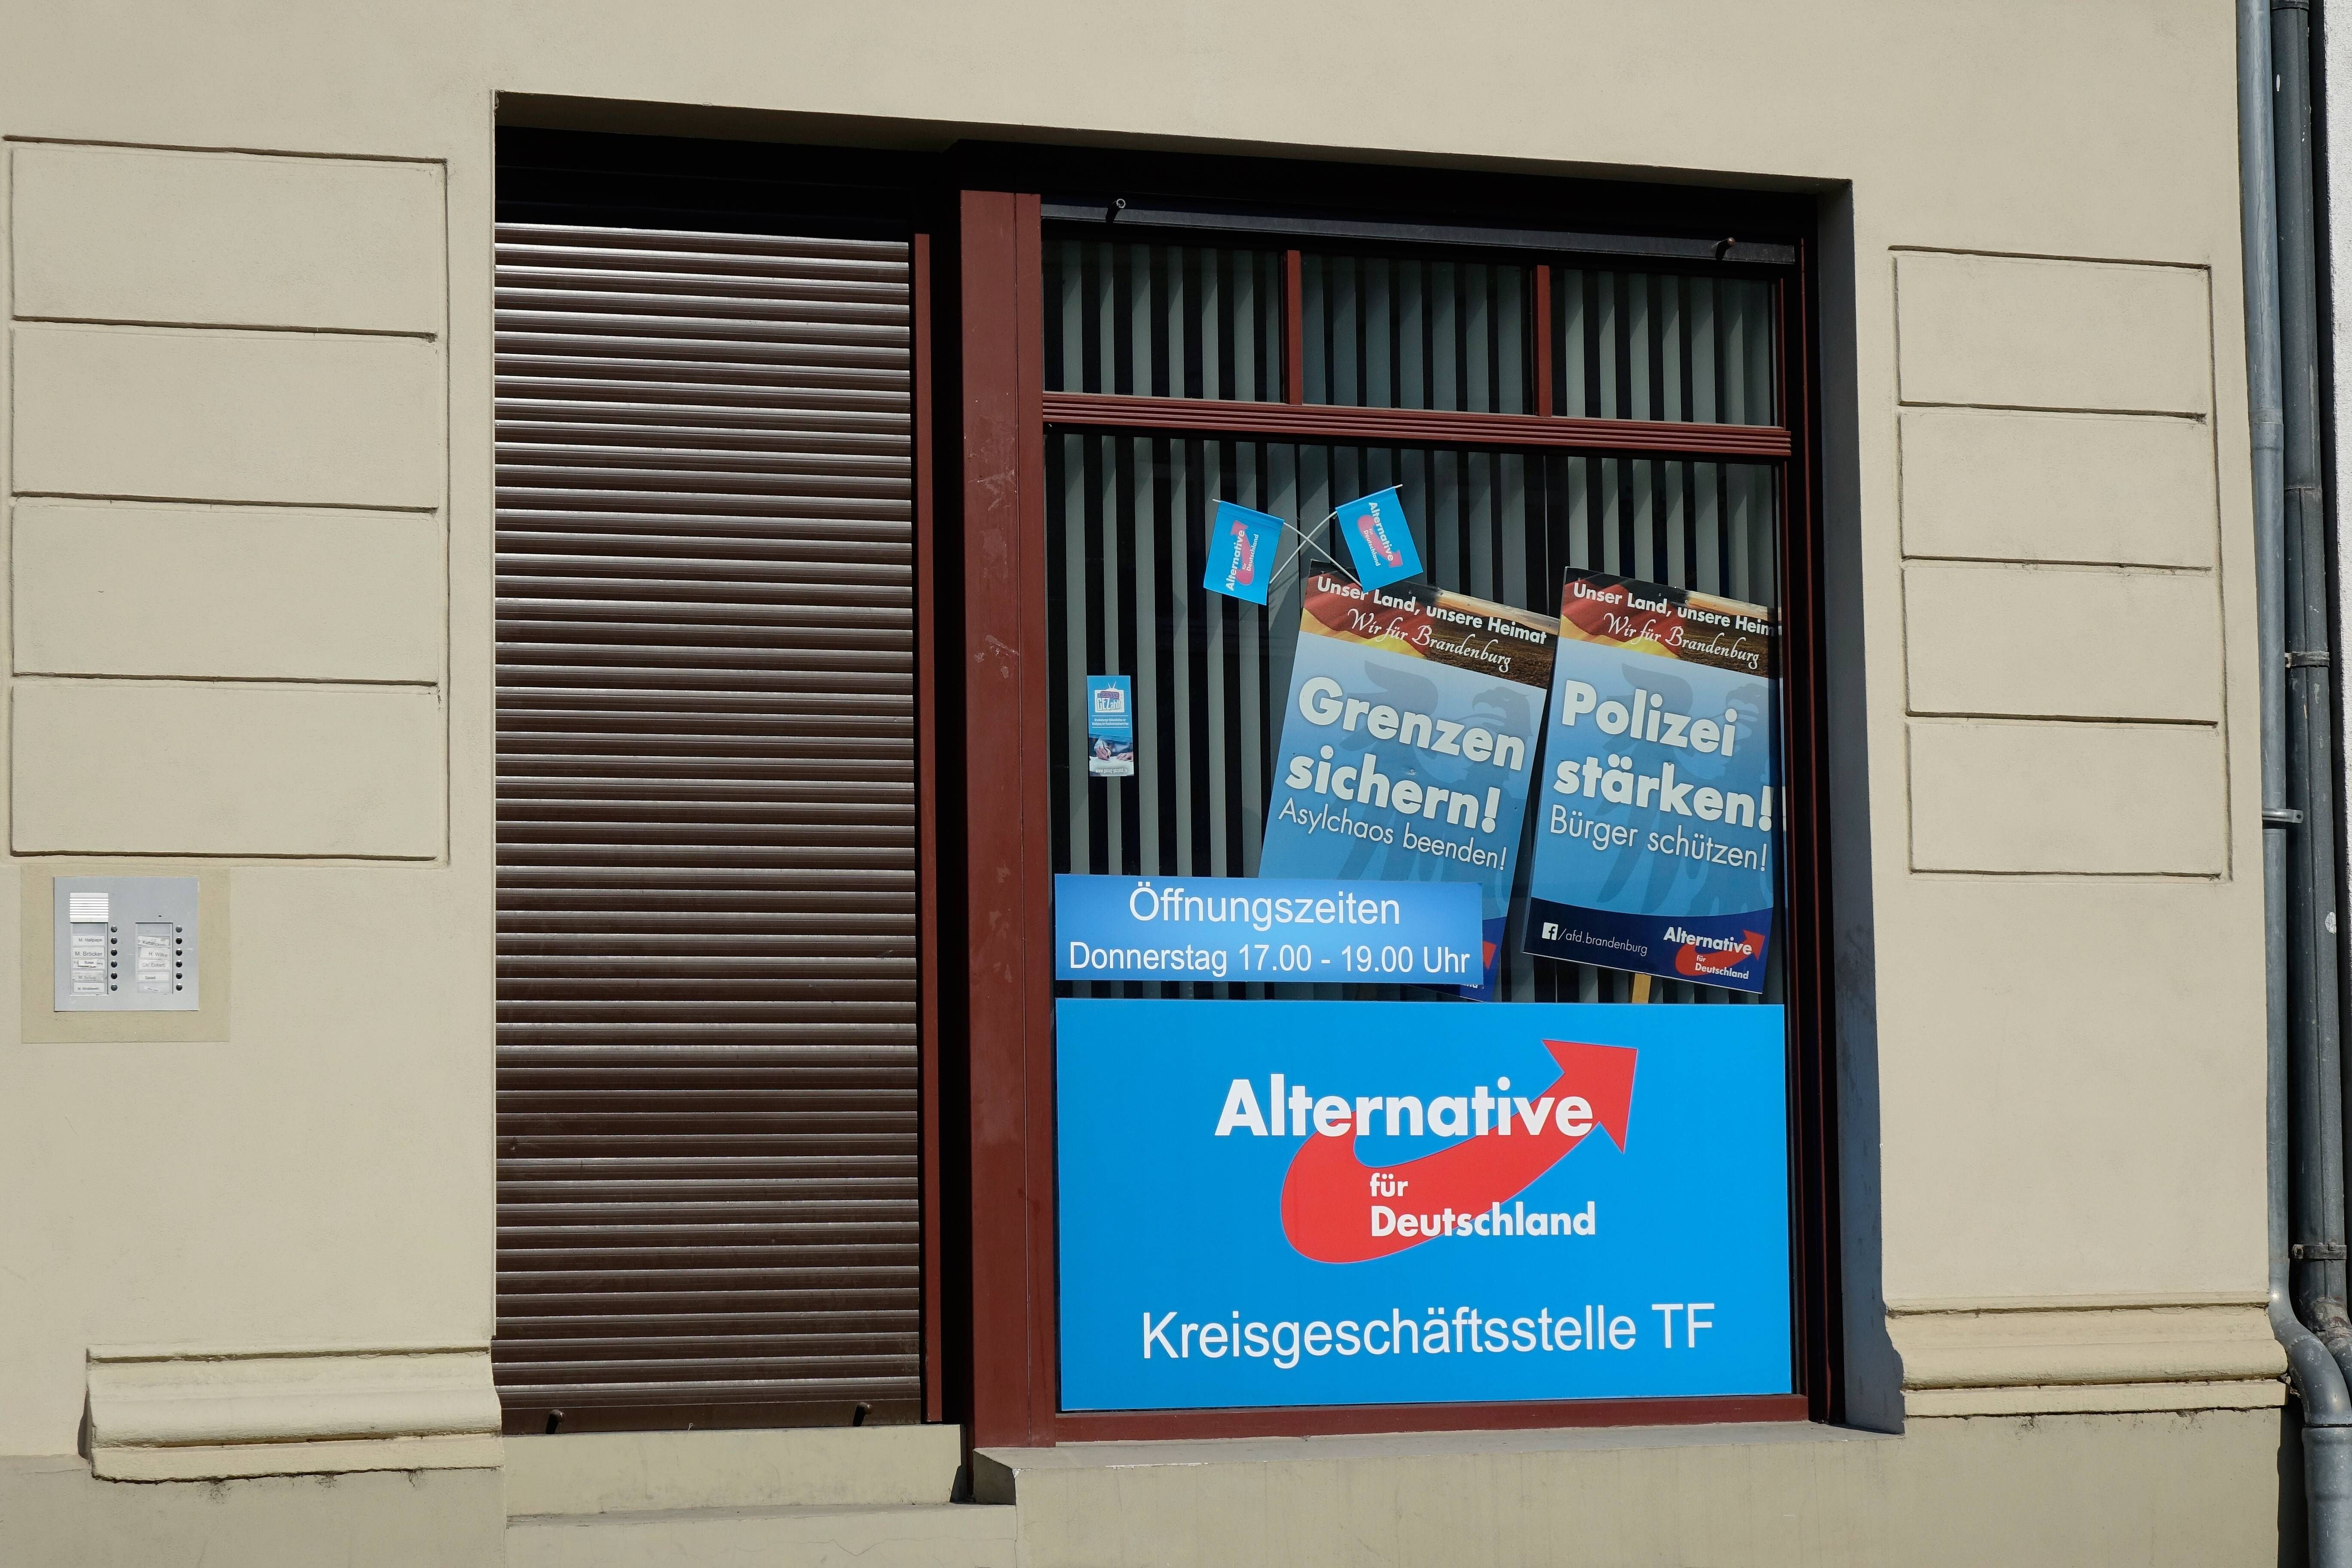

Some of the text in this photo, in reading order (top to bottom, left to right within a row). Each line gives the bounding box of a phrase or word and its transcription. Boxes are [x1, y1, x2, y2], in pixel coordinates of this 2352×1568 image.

[1226, 530, 1245, 591] Alternative
[1246, 533, 1259, 571] Deutschland
[1363, 530, 1381, 567] Deutschland
[1369, 502, 1393, 561] Alternative
[1317, 576, 1547, 644] Unser Land, unsere Heimat
[1574, 582, 1782, 636] Unser Land, unsere Heim
[1347, 608, 1512, 673] Wir für Brandenburg
[1603, 613, 1760, 670] Wir für Brandenburg
[1299, 677, 1525, 771] Grenzen
[1562, 680, 1737, 756] Polizei
[1285, 745, 1501, 833] sichern!
[1553, 753, 1774, 832] stärken!
[1278, 797, 1507, 871] Asylchaos beenden!
[1550, 804, 1767, 872] Bürger schützen!
[1129, 881, 1400, 931] Öffnungszeiten
[1069, 941, 1228, 977] Donnerstag
[1239, 944, 1312, 972] 17.00
[1341, 945, 1413, 973] 19.00
[1424, 946, 1470, 974] Uhr
[1663, 926, 1752, 956] Alternative
[1696, 955, 1706, 963] für
[1695, 962, 1749, 980] Deutschland
[1214, 1073, 1593, 1137] Alternative
[1369, 1172, 1408, 1197] für
[1371, 1201, 1596, 1237] Deutschland
[1142, 1303, 1715, 1369] Kreisgeschäftsstelle TF
